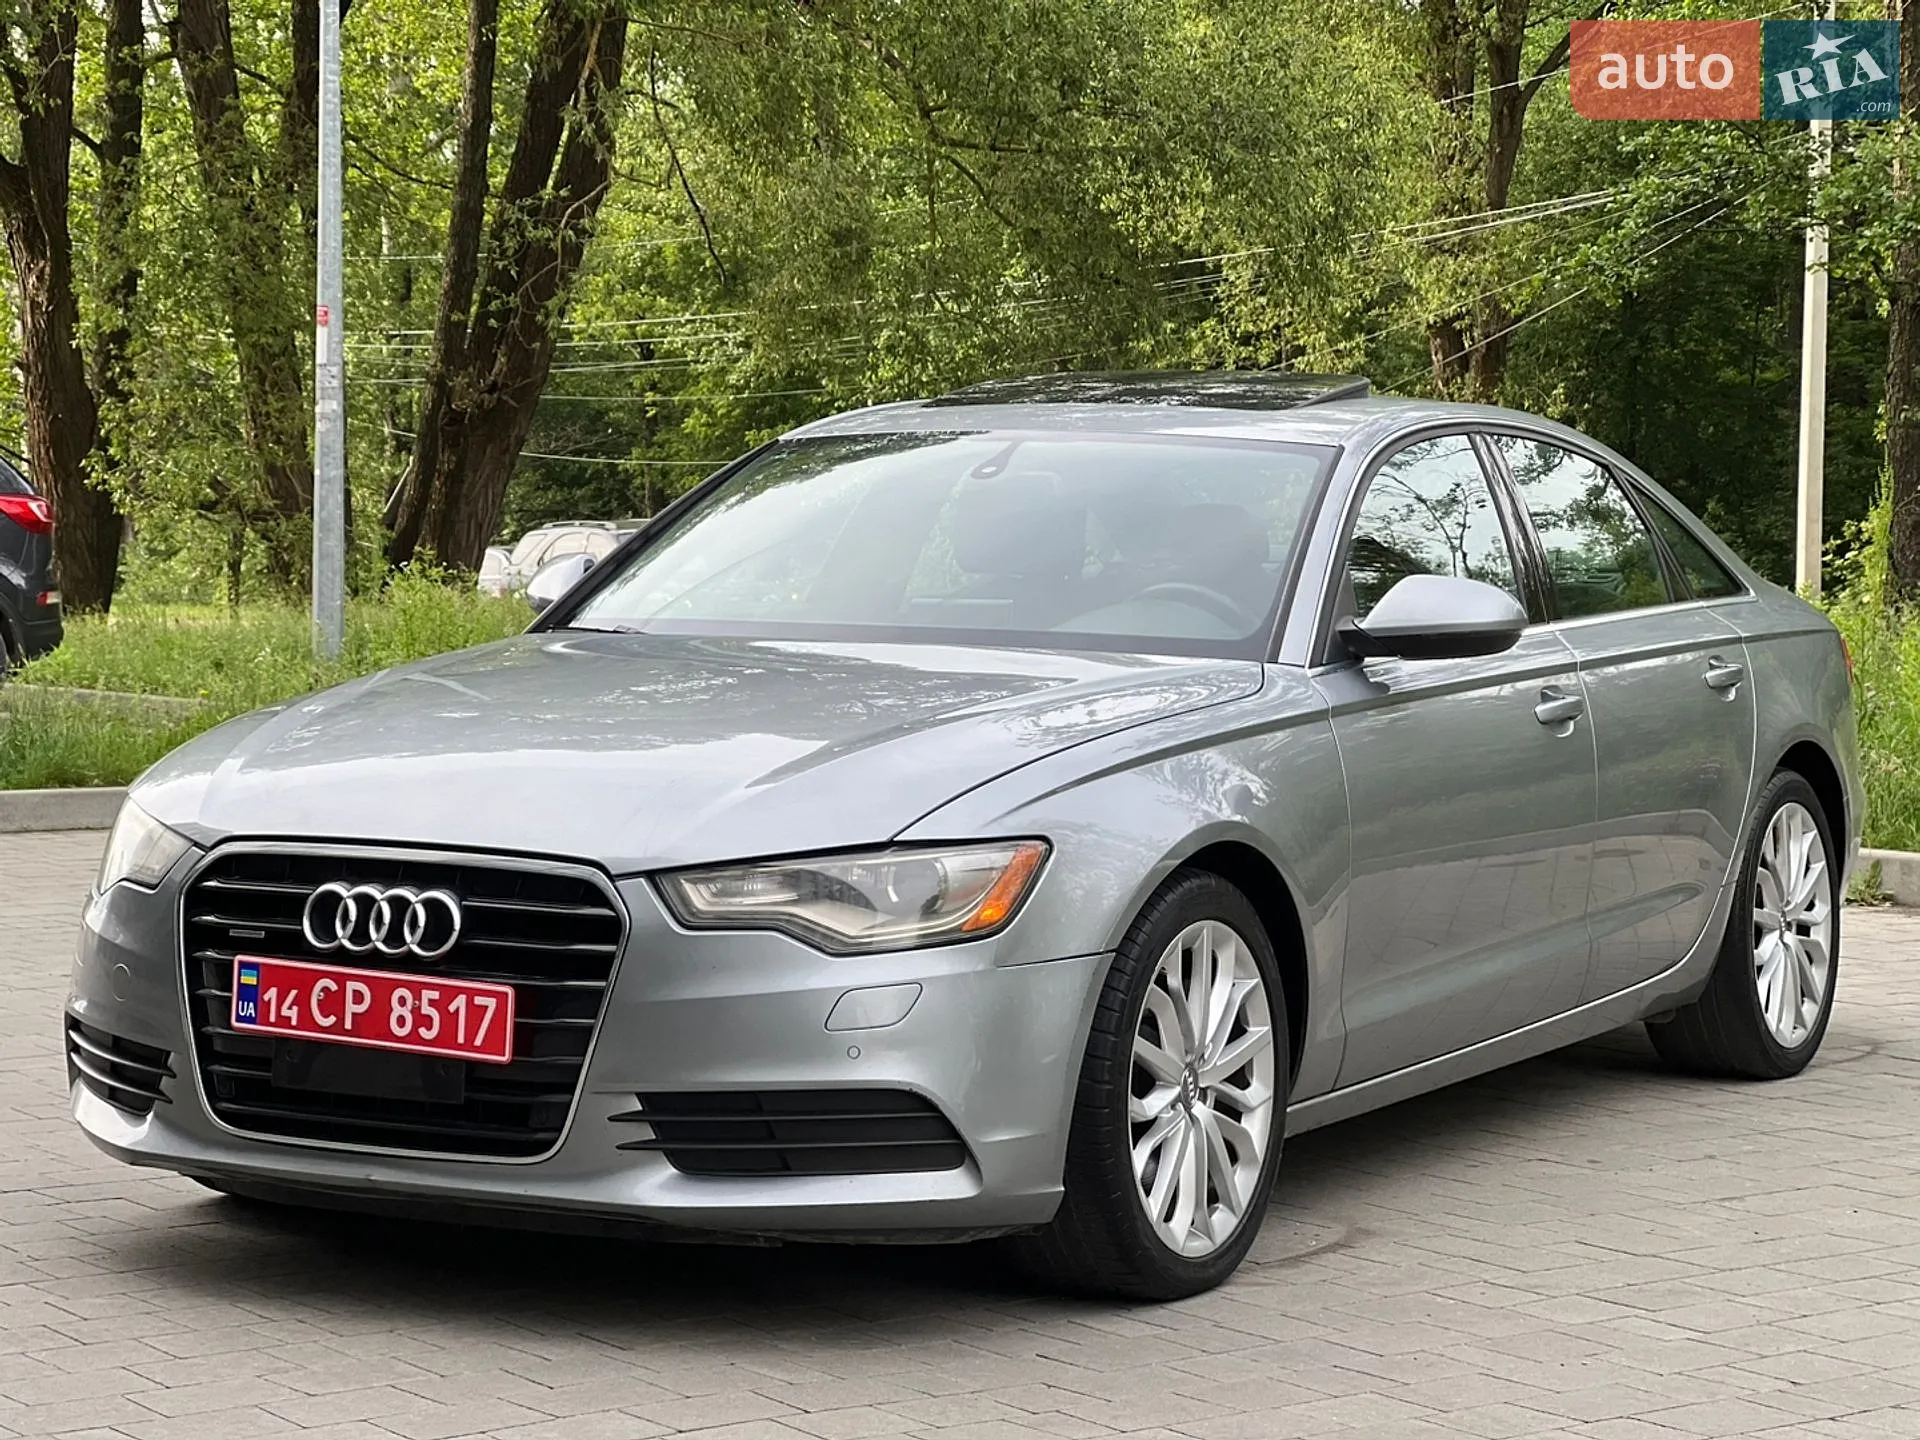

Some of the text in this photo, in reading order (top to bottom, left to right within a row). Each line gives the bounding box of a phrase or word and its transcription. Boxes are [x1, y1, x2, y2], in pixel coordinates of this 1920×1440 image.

[238, 1001, 256, 1018] UA
[262, 978, 497, 1047] 14 CP 8517
